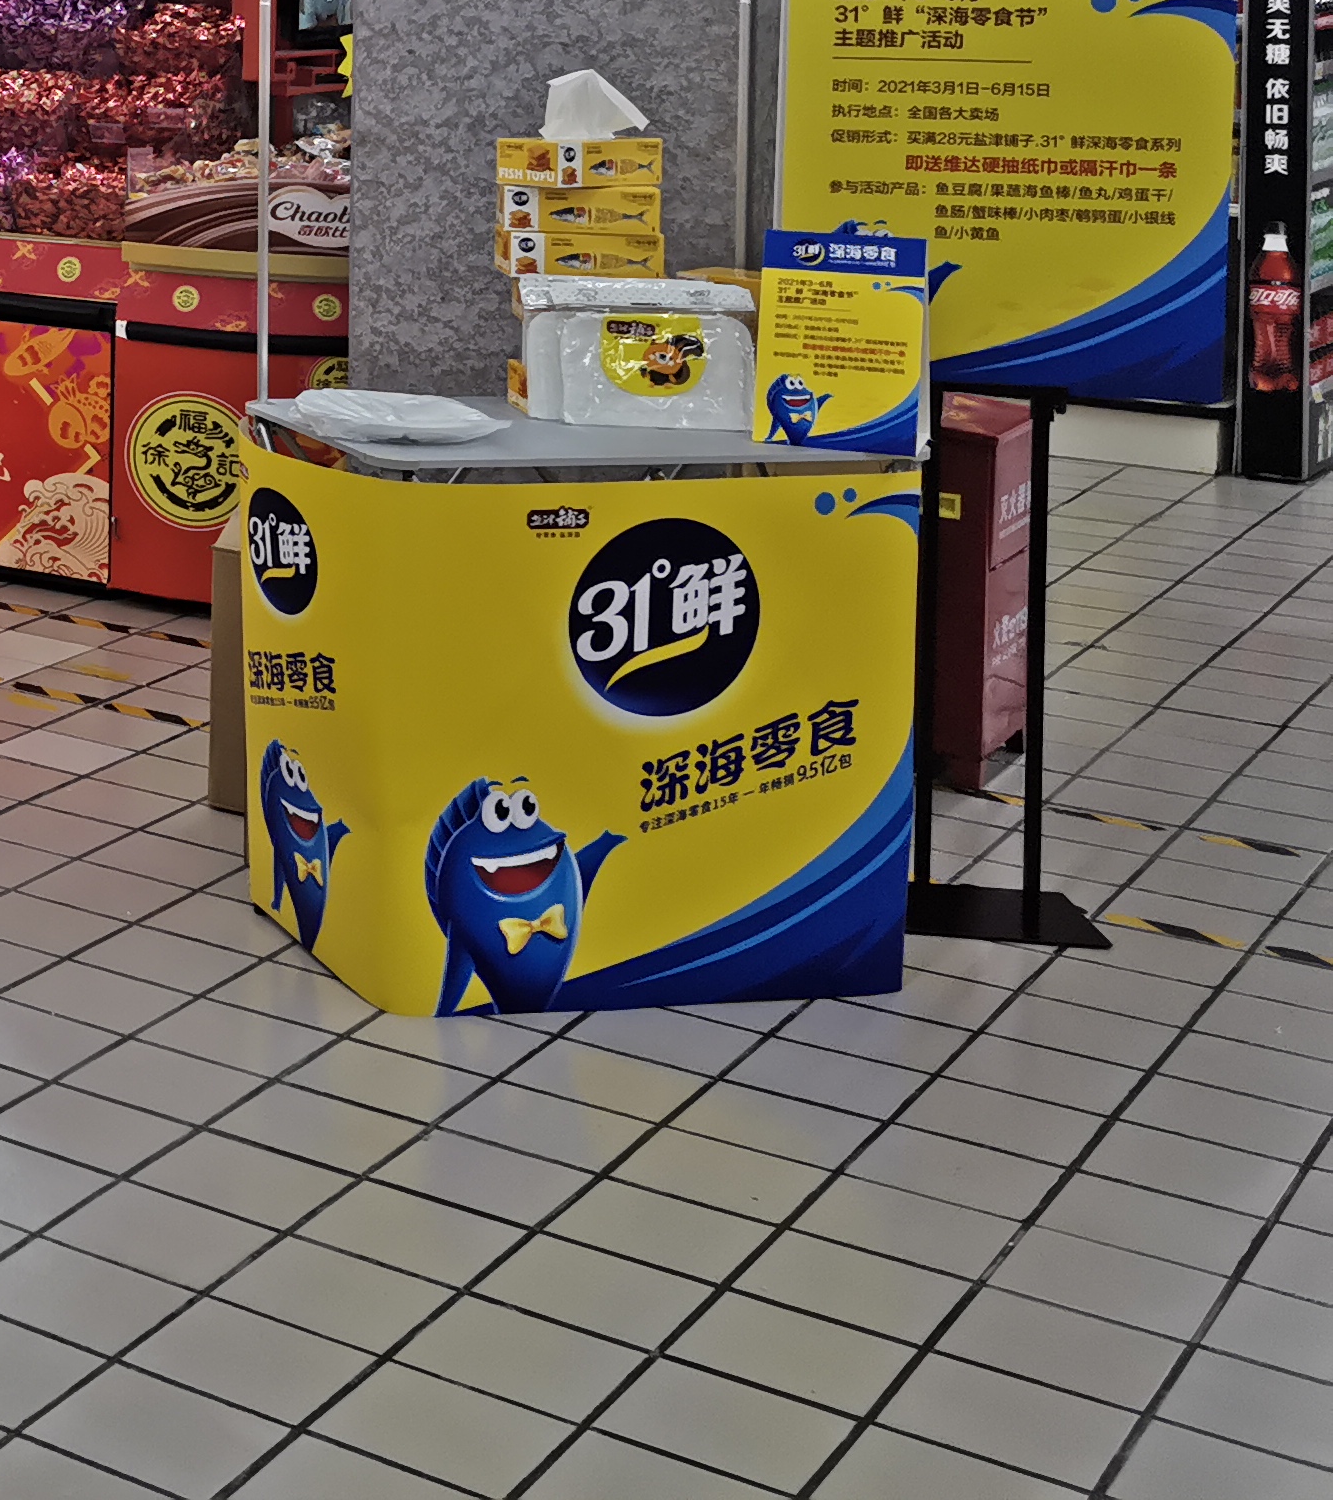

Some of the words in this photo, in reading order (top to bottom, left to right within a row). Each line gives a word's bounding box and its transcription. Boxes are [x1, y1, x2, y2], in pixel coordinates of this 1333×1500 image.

[833, 29, 965, 50] 主题推广活动
[1264, 77, 1290, 176] 依旧畅爽
[498, 167, 524, 180] FISH
[526, 169, 555, 183] TOFU
[904, 155, 1178, 180] 即送维达硬抽纸巾或隔汗巾一条
[933, 224, 1001, 242] 鱼/小黄鱼
[247, 648, 337, 696] 深海零食
[639, 698, 860, 813] 深海零食
